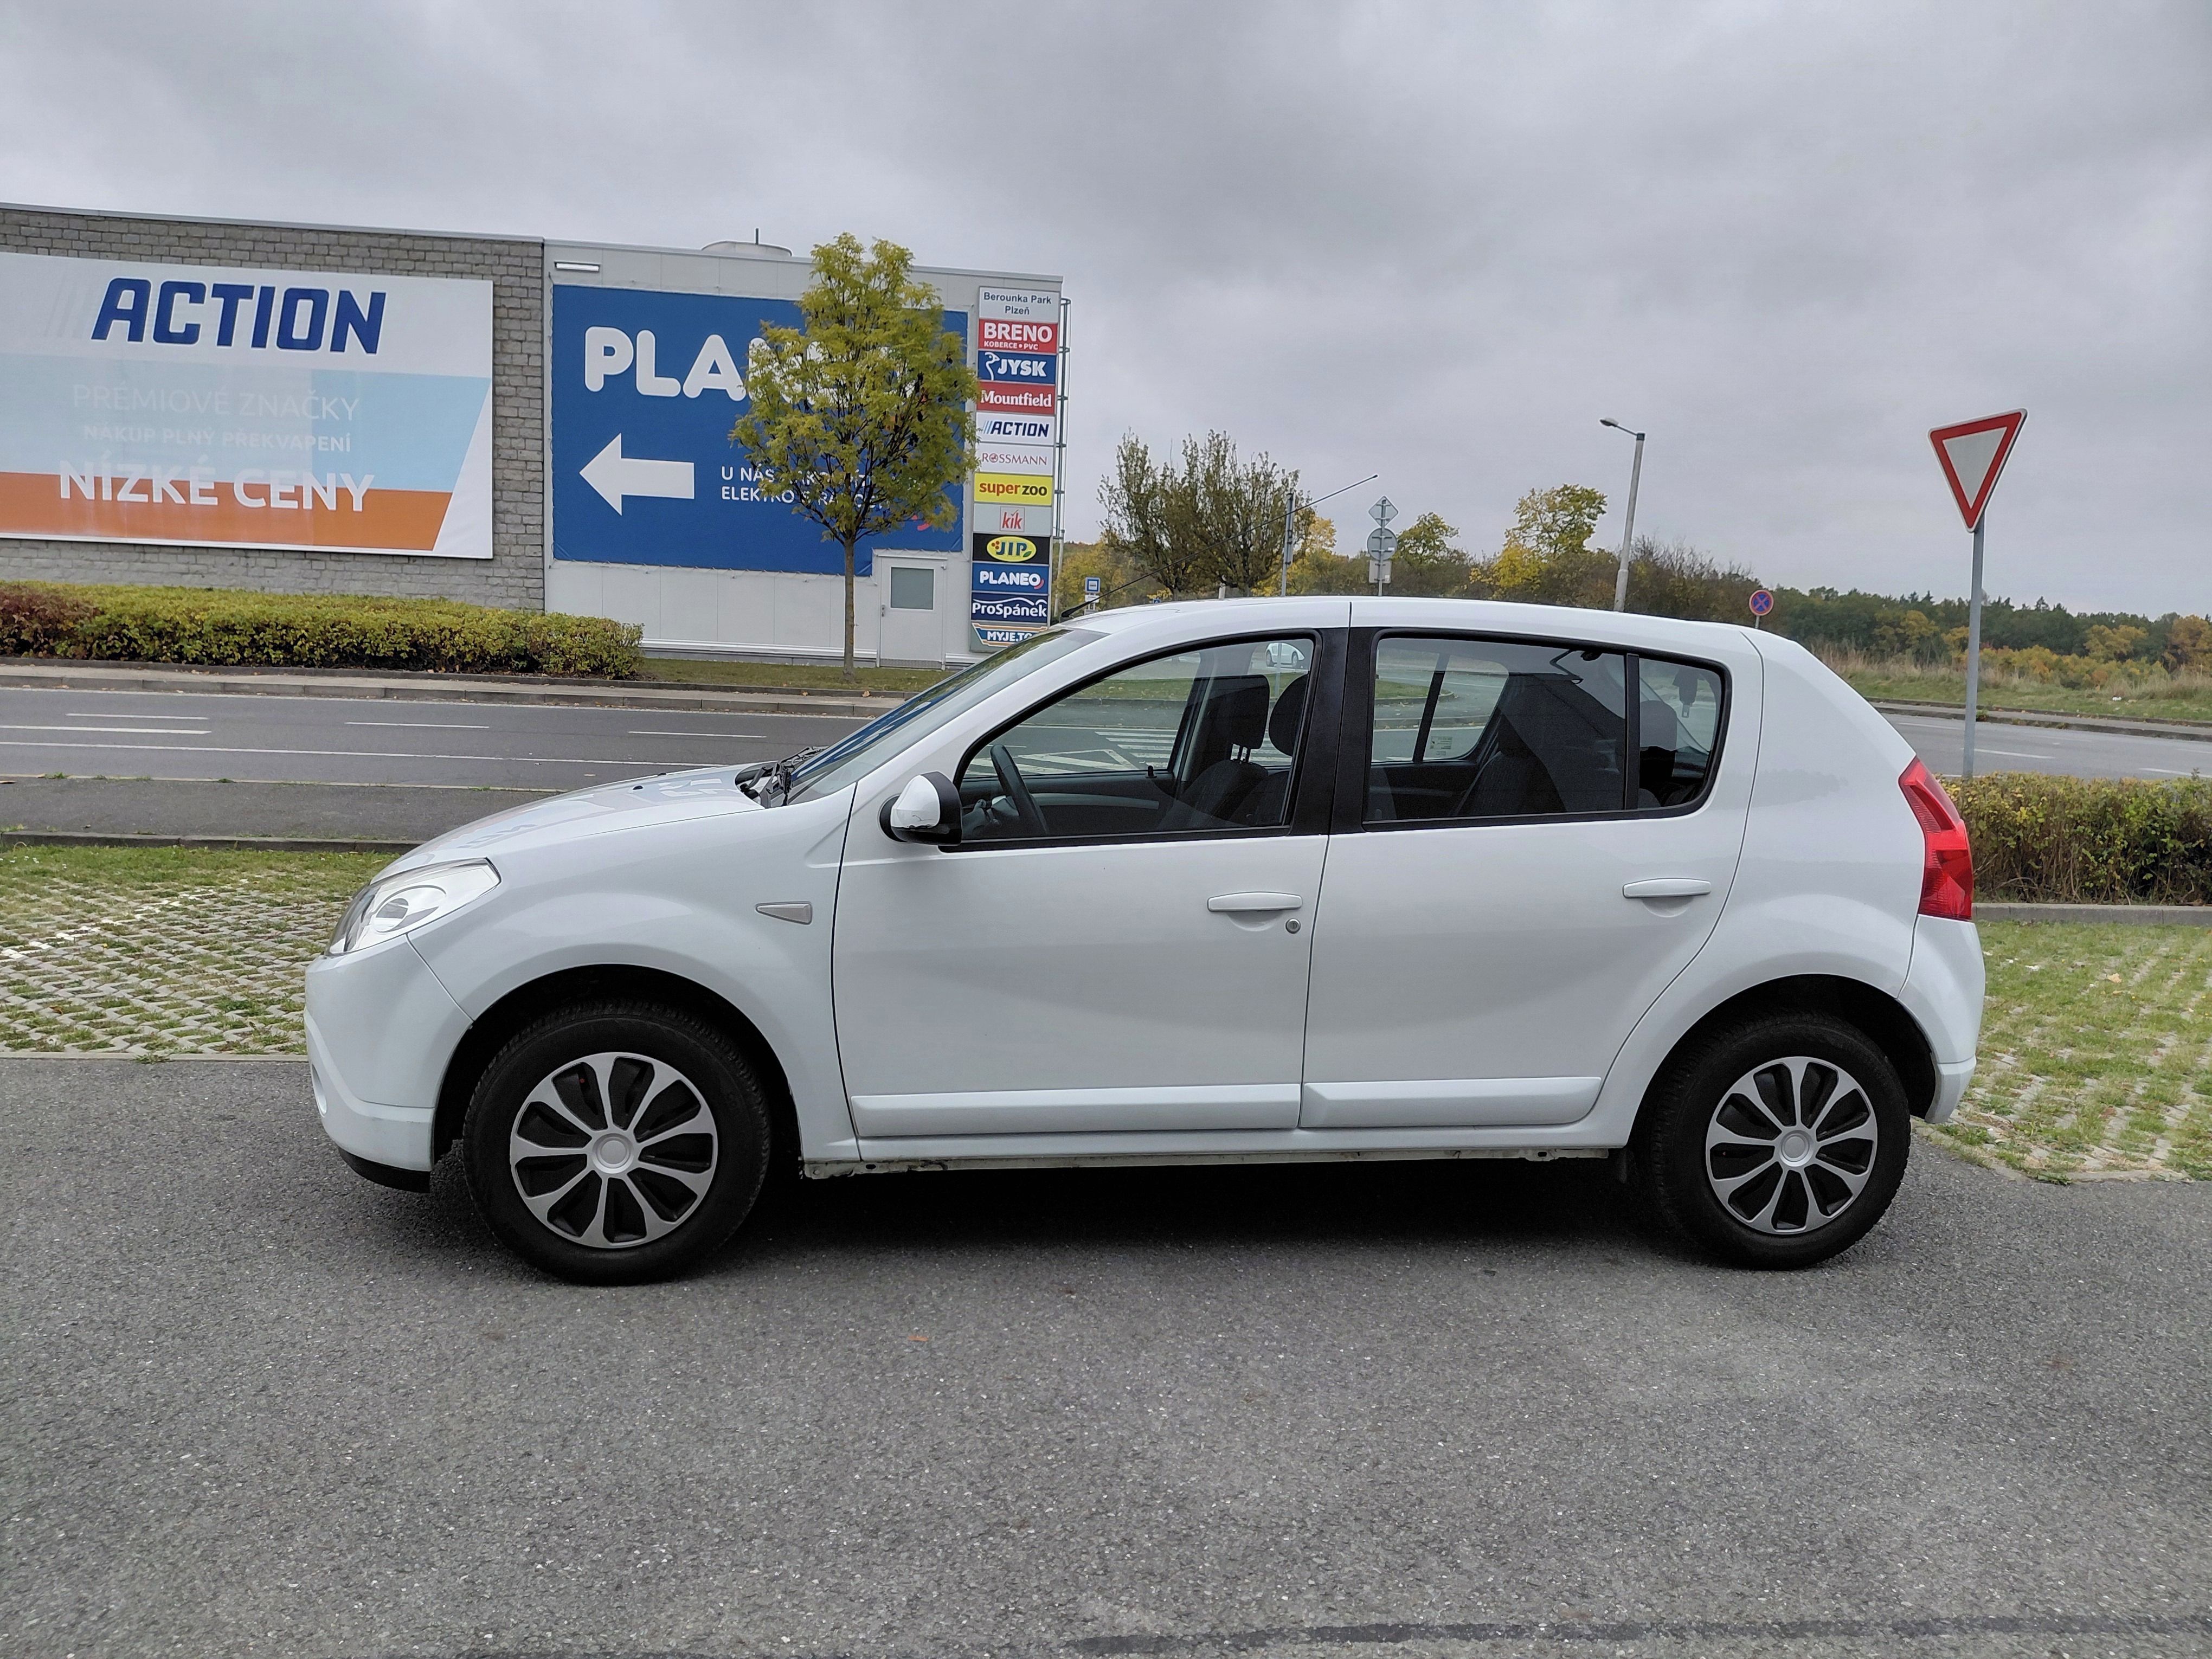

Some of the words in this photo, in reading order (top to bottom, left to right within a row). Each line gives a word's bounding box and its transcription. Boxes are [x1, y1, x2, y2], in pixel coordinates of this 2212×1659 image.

[983, 292, 1028, 303] Berounka
[1031, 295, 1052, 304] Park
[91, 277, 387, 355] ACTION
[1005, 305, 1030, 315] Plzeň
[984, 321, 1053, 343] BRENO
[984, 340, 1018, 349] KOBERCE
[998, 358, 1047, 377] JYSK
[72, 380, 230, 415] PRÉMIOVÉ
[239, 389, 360, 421] ZNAČKY
[980, 390, 1052, 408] Mountfield
[990, 421, 1050, 438] ACTION
[162, 427, 215, 445] PLNÝ
[221, 427, 351, 452] PŘEKVAPENÍ
[982, 453, 1047, 466] ROSSMANN
[60, 449, 218, 505] NÍZKÉ
[233, 467, 375, 512] CENY
[722, 466, 734, 480] U
[1002, 510, 1023, 529] kik
[996, 542, 1027, 556] JIP
[979, 570, 1041, 587] PLANEO
[972, 602, 1047, 619] ProSpánek
